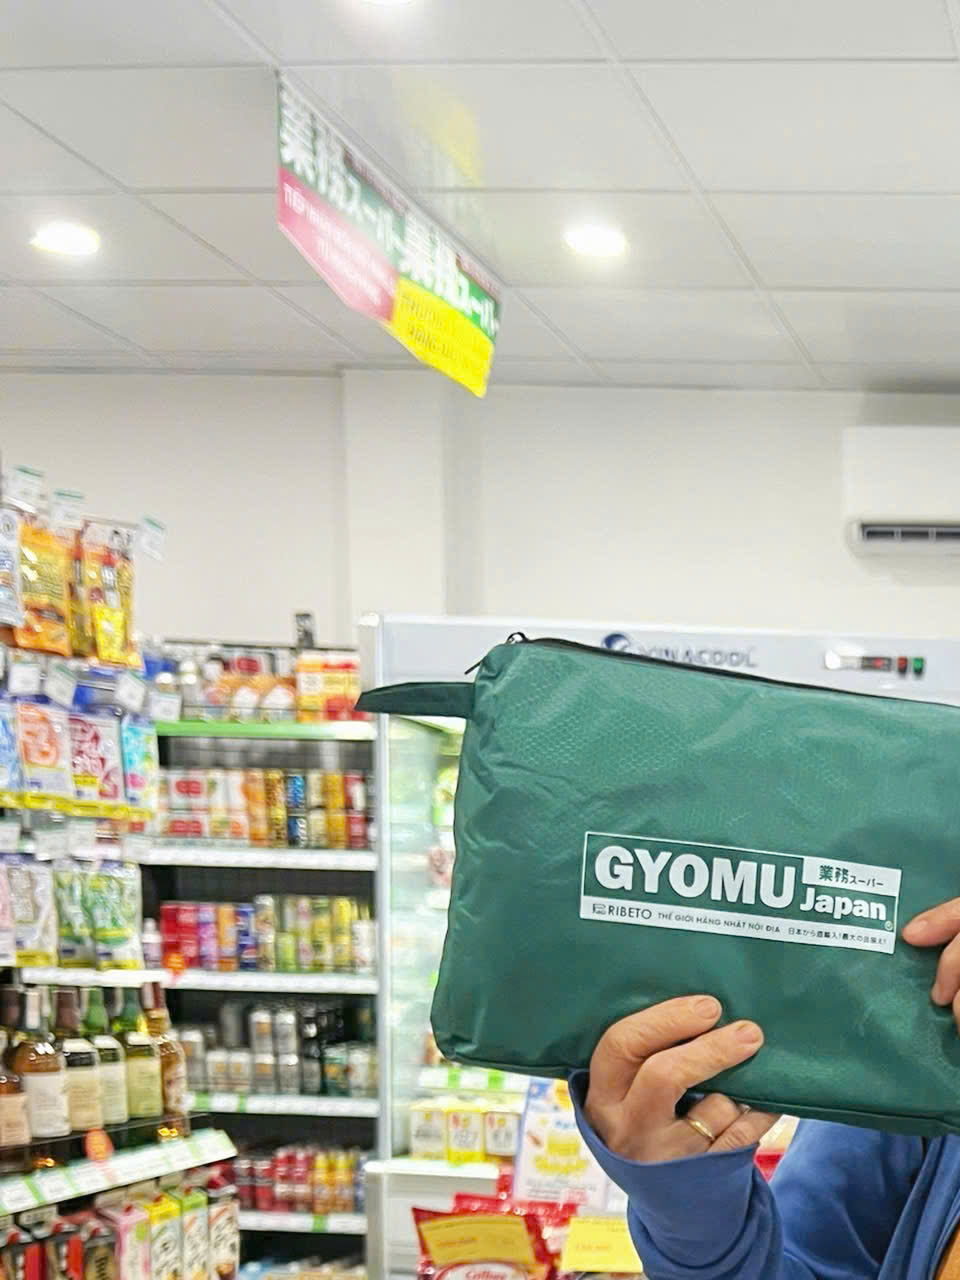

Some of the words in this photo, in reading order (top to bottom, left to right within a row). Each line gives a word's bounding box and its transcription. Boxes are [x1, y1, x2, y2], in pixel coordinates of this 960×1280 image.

[594, 845, 797, 909] GYOMU
[818, 864, 885, 888] 業務スーパー
[608, 903, 652, 920] RIBETO
[799, 886, 887, 921] Japan
